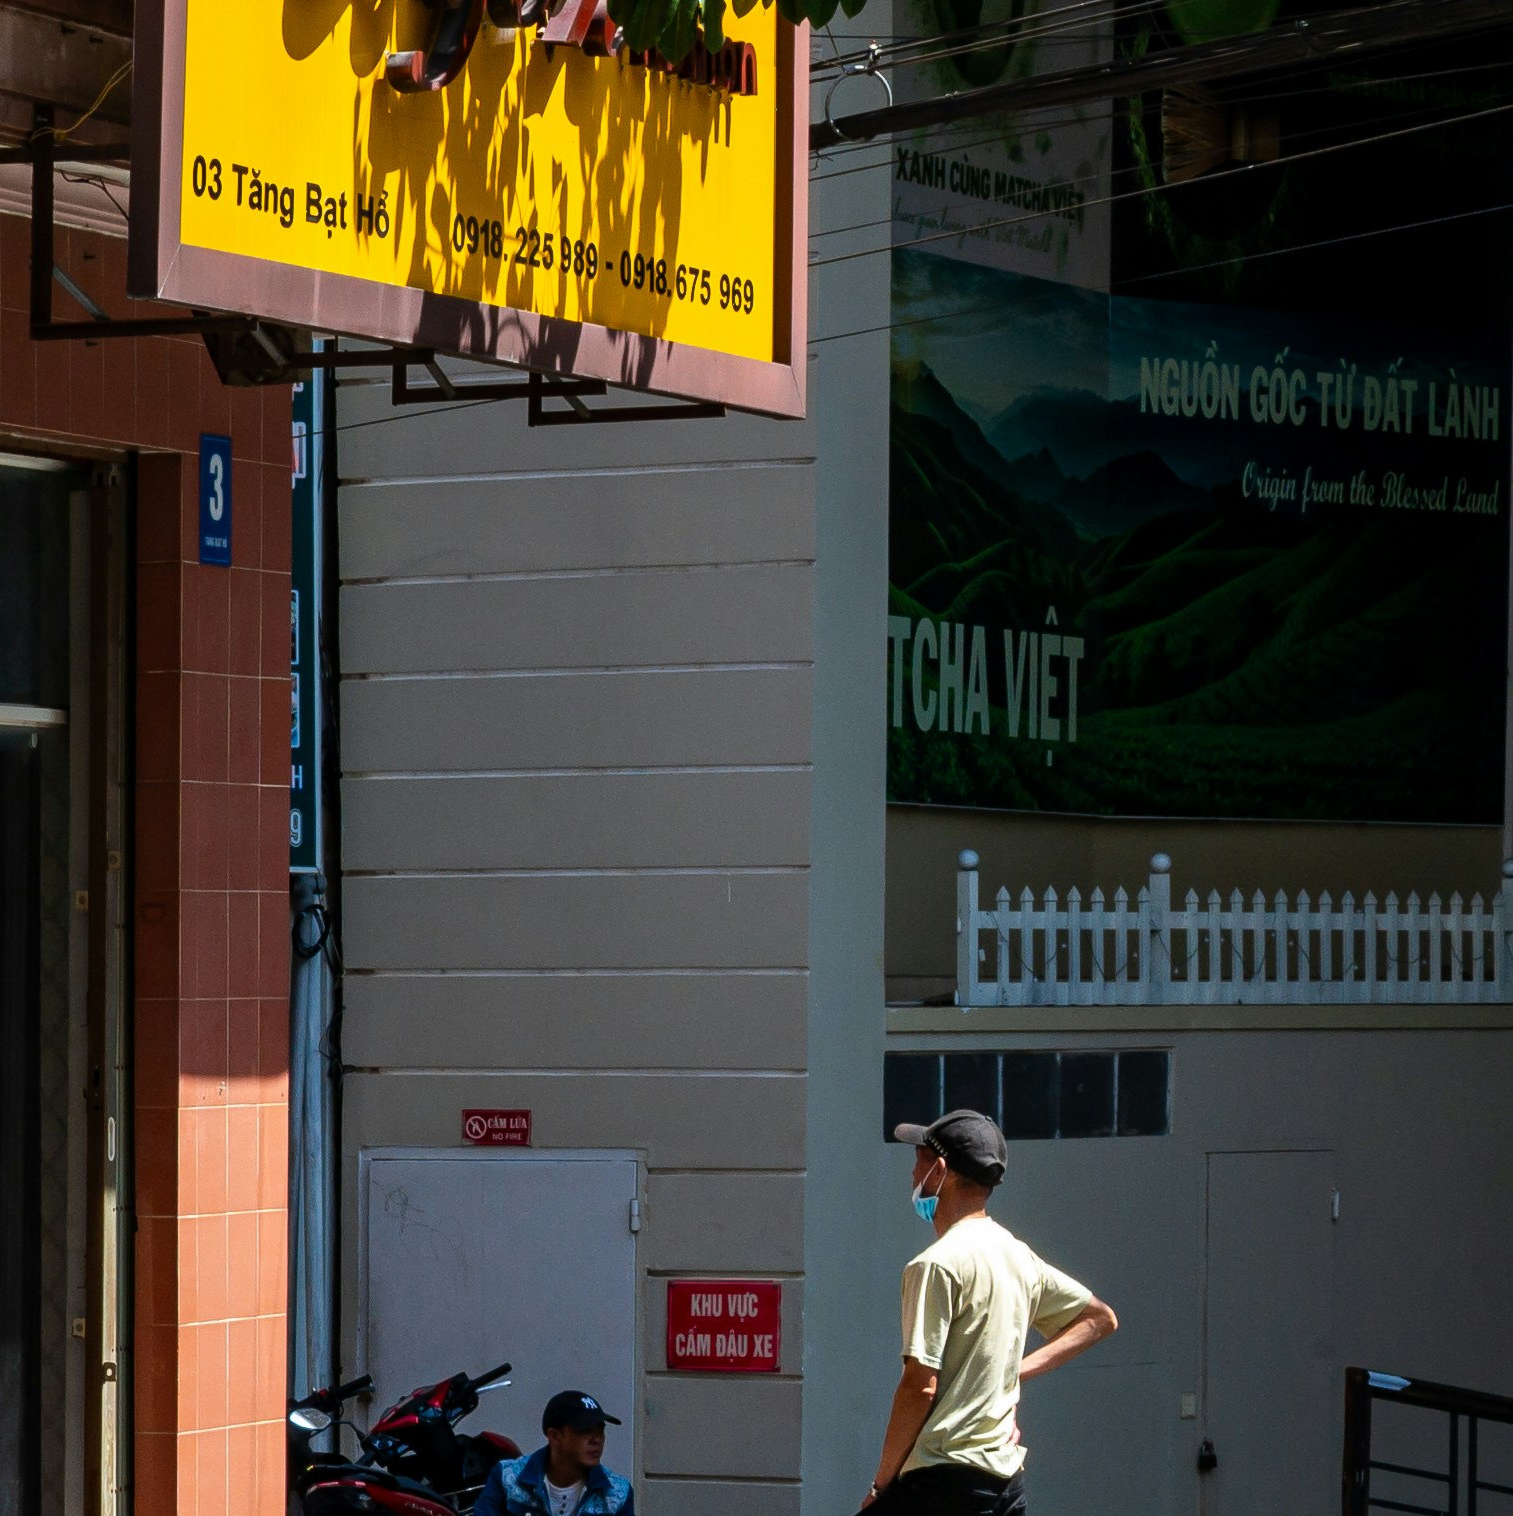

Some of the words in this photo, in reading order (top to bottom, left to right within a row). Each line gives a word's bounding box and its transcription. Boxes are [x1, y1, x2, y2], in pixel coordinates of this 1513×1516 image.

[896, 147, 946, 190] XANH
[950, 153, 990, 200] CÙNG
[994, 172, 1050, 212] MATCHA
[192, 155, 222, 200] 03
[232, 163, 294, 228] Tăng
[305, 182, 347, 238] Bạt
[357, 190, 389, 238] Hổ
[454, 213, 507, 262] 0918.
[515, 226, 554, 270] 225
[560, 236, 598, 279] 989
[719, 273, 754, 315] 969
[1139, 340, 1240, 420] NGUỒN
[1249, 346, 1306, 426] GỐC
[1316, 357, 1357, 429] TỪ
[1362, 357, 1418, 434] ĐẤT
[1428, 367, 1500, 441] LÀNH
[209, 453, 224, 521] 3
[1242, 460, 1297, 512] Origin
[1302, 465, 1345, 514] from
[1349, 469, 1374, 508] the
[1380, 471, 1448, 512] Blessed
[1452, 477, 1501, 516] Land
[888, 614, 990, 736] TCHA
[1003, 605, 1086, 767] VIỆT
[691, 1294, 723, 1318] KHU
[727, 1292, 758, 1322] VỰC
[675, 1325, 711, 1357] CẤM
[716, 1329, 748, 1362] ĐẬU
[753, 1334, 773, 1358] XE
